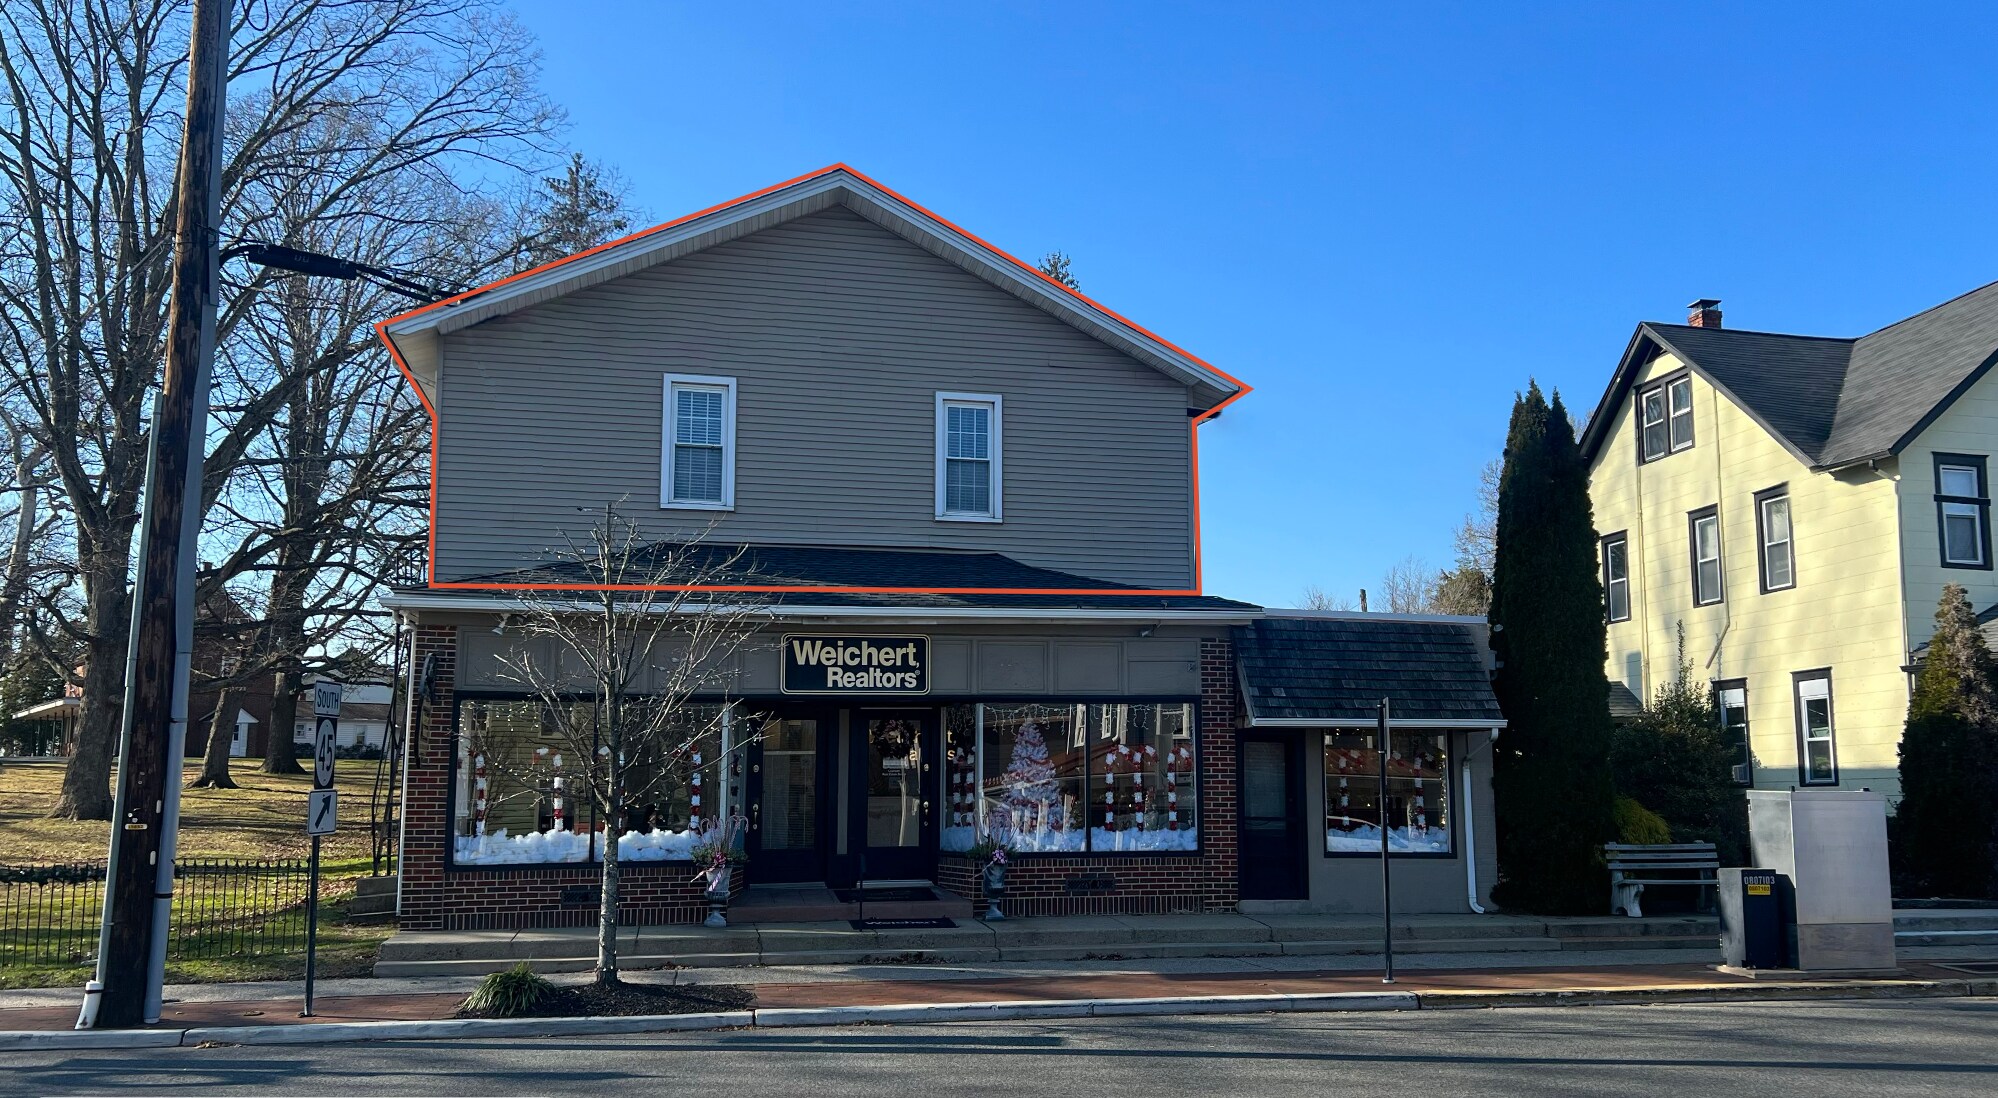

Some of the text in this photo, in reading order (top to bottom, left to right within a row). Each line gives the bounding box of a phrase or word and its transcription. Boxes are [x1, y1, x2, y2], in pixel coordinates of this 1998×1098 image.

[792, 640, 920, 668] Weichert,
[317, 688, 339, 710] SOUTH
[318, 734, 334, 772] 45
[1744, 876, 1775, 885] 0807103
